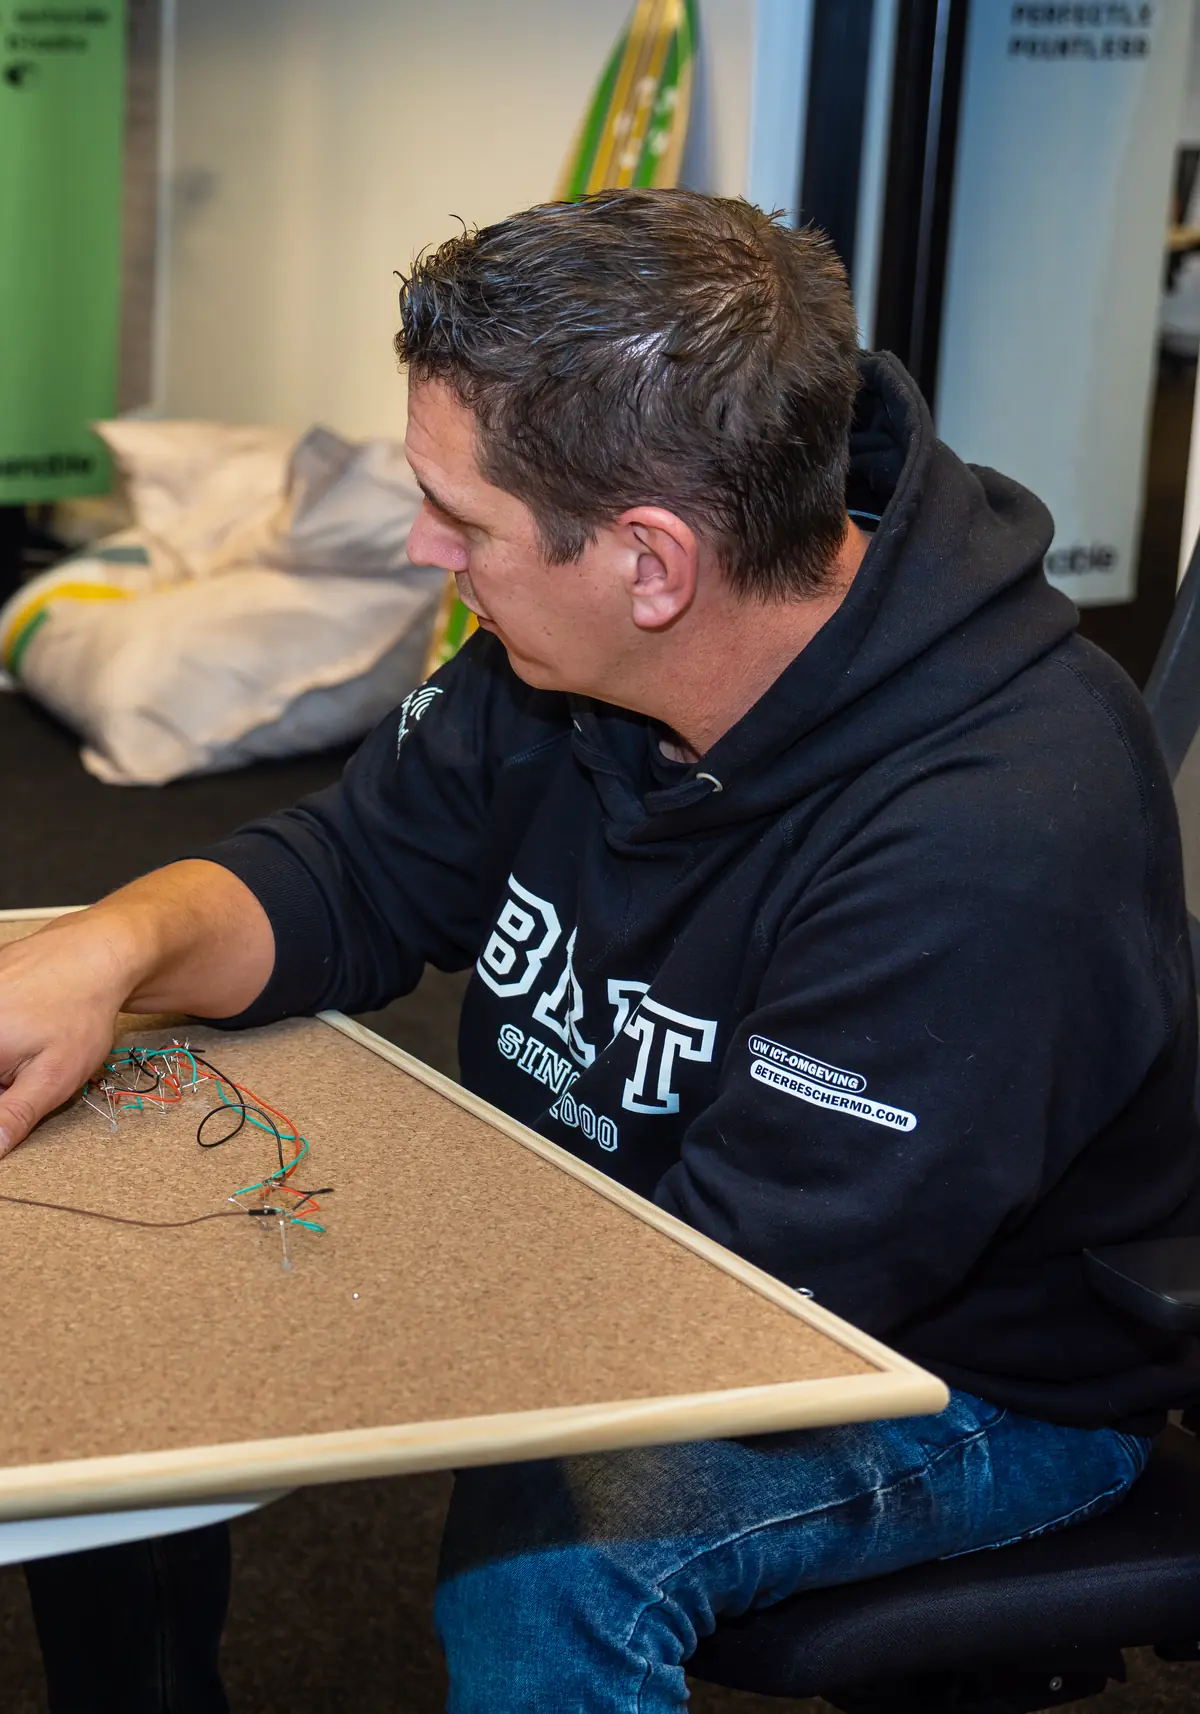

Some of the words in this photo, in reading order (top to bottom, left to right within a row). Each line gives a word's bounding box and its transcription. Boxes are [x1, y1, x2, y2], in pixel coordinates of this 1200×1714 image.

[753, 1039, 769, 1055] UW
[769, 1047, 859, 1090] ICT-OMGEVING
[754, 1064, 909, 1127] BETERBESCHERMD.COM
